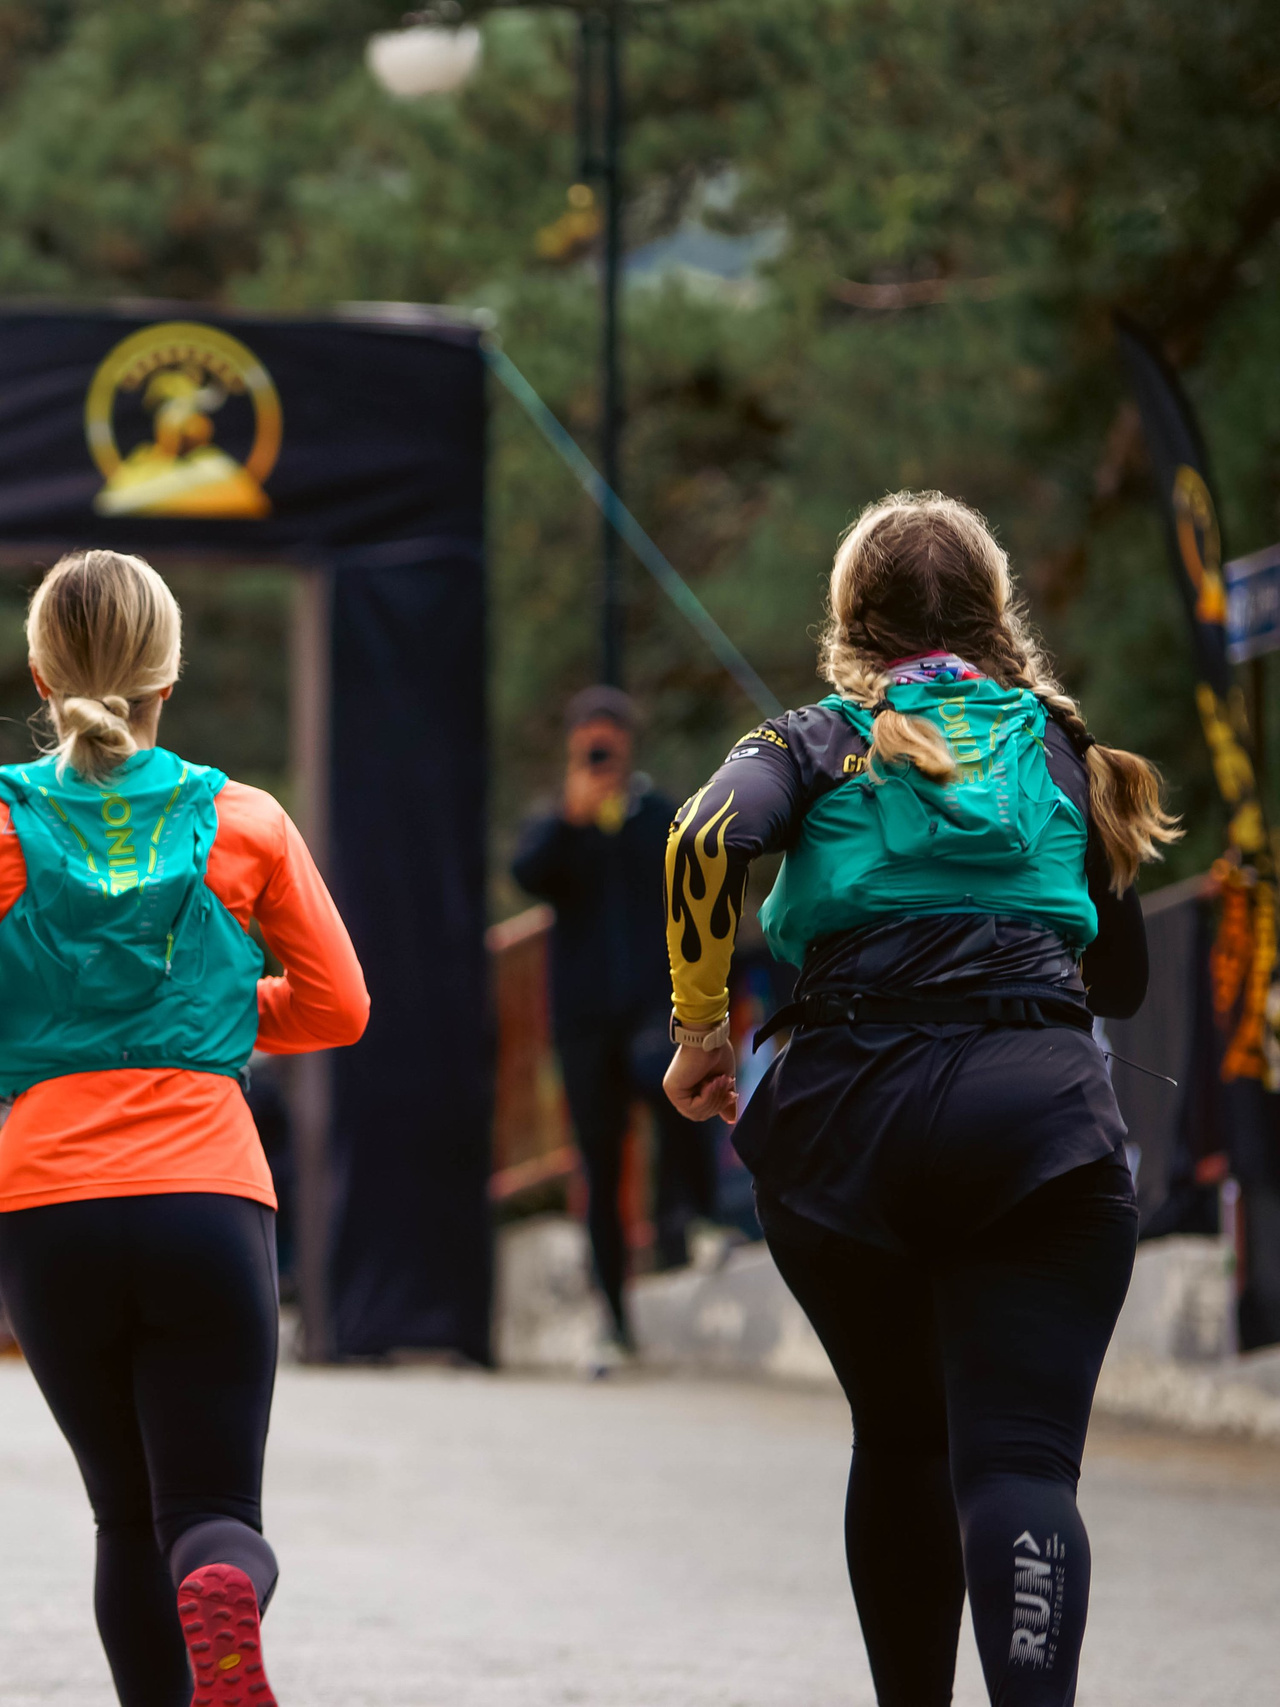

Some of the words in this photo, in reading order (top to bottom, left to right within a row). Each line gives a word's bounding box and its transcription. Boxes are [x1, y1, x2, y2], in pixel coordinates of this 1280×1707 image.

[1010, 1557, 1052, 1669] RUN
[1046, 1642, 1058, 1669] THE
[1053, 1566, 1065, 1636] DISTANCE
